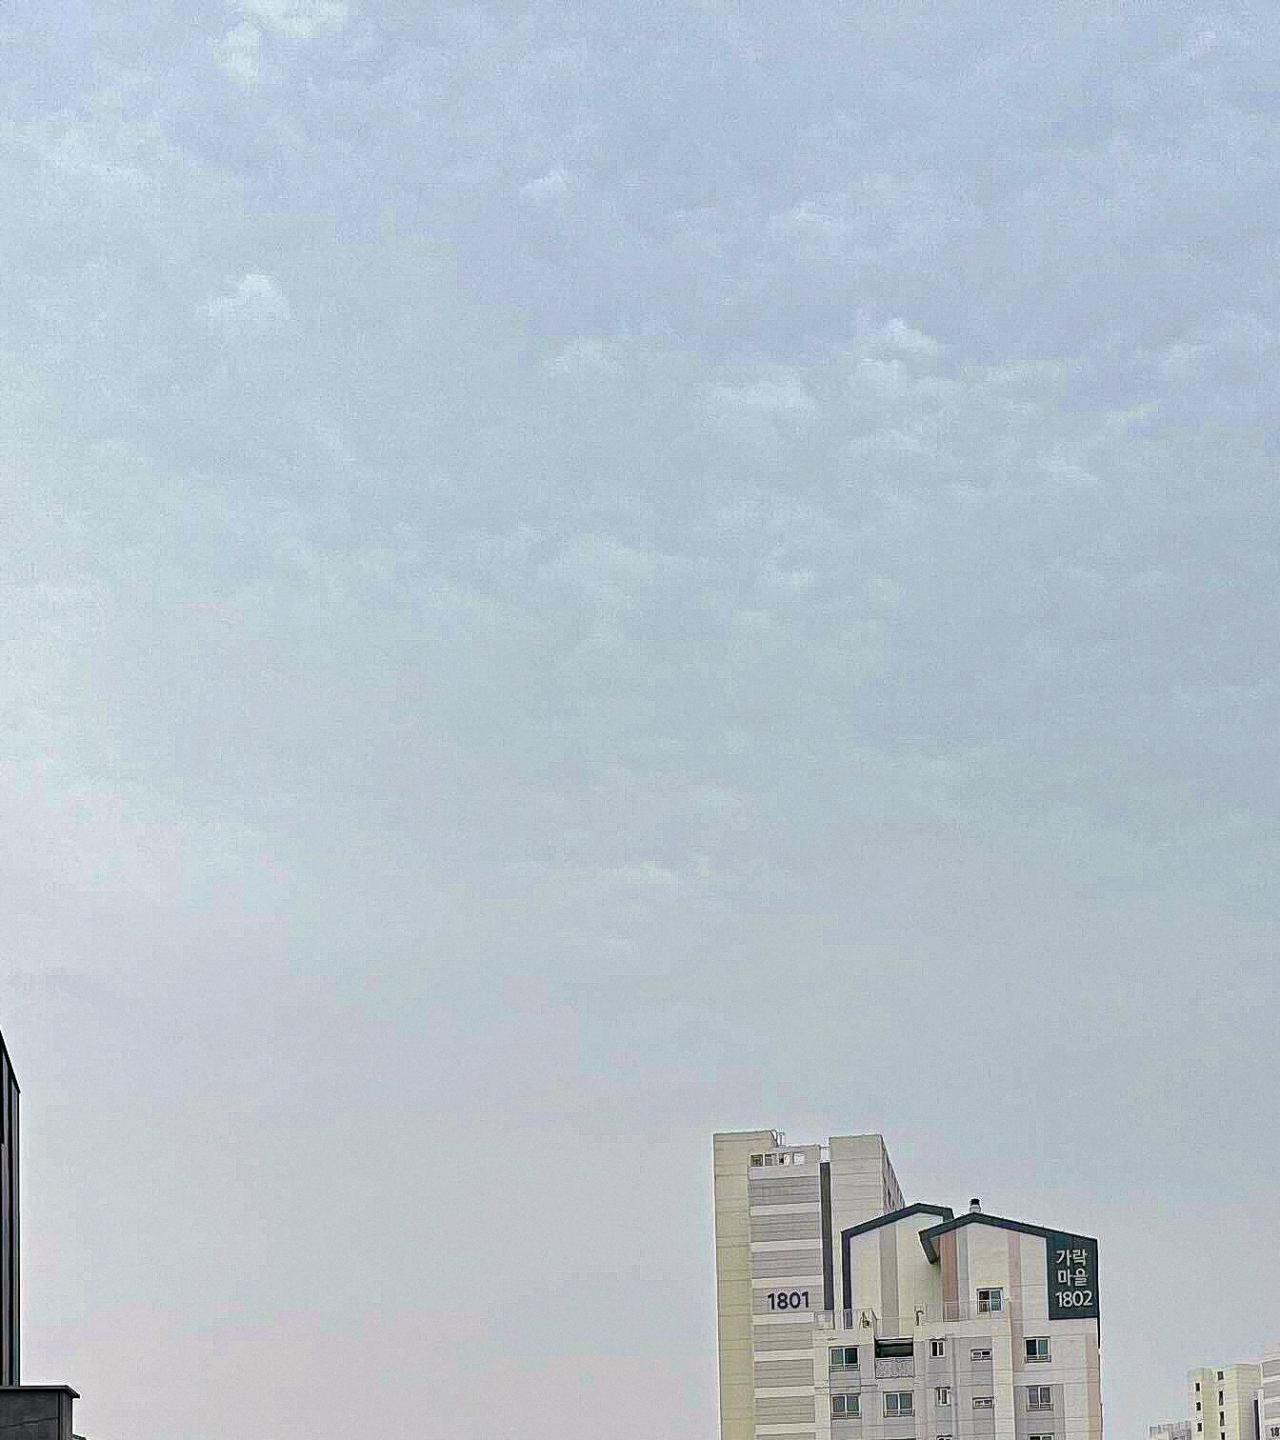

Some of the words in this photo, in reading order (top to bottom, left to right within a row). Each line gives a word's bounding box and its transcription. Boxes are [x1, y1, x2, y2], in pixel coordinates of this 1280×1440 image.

[1056, 1249, 1088, 1267] 가락
[1057, 1268, 1088, 1287] 마을
[767, 1291, 809, 1310] 1801
[1055, 1290, 1093, 1308] 1802
